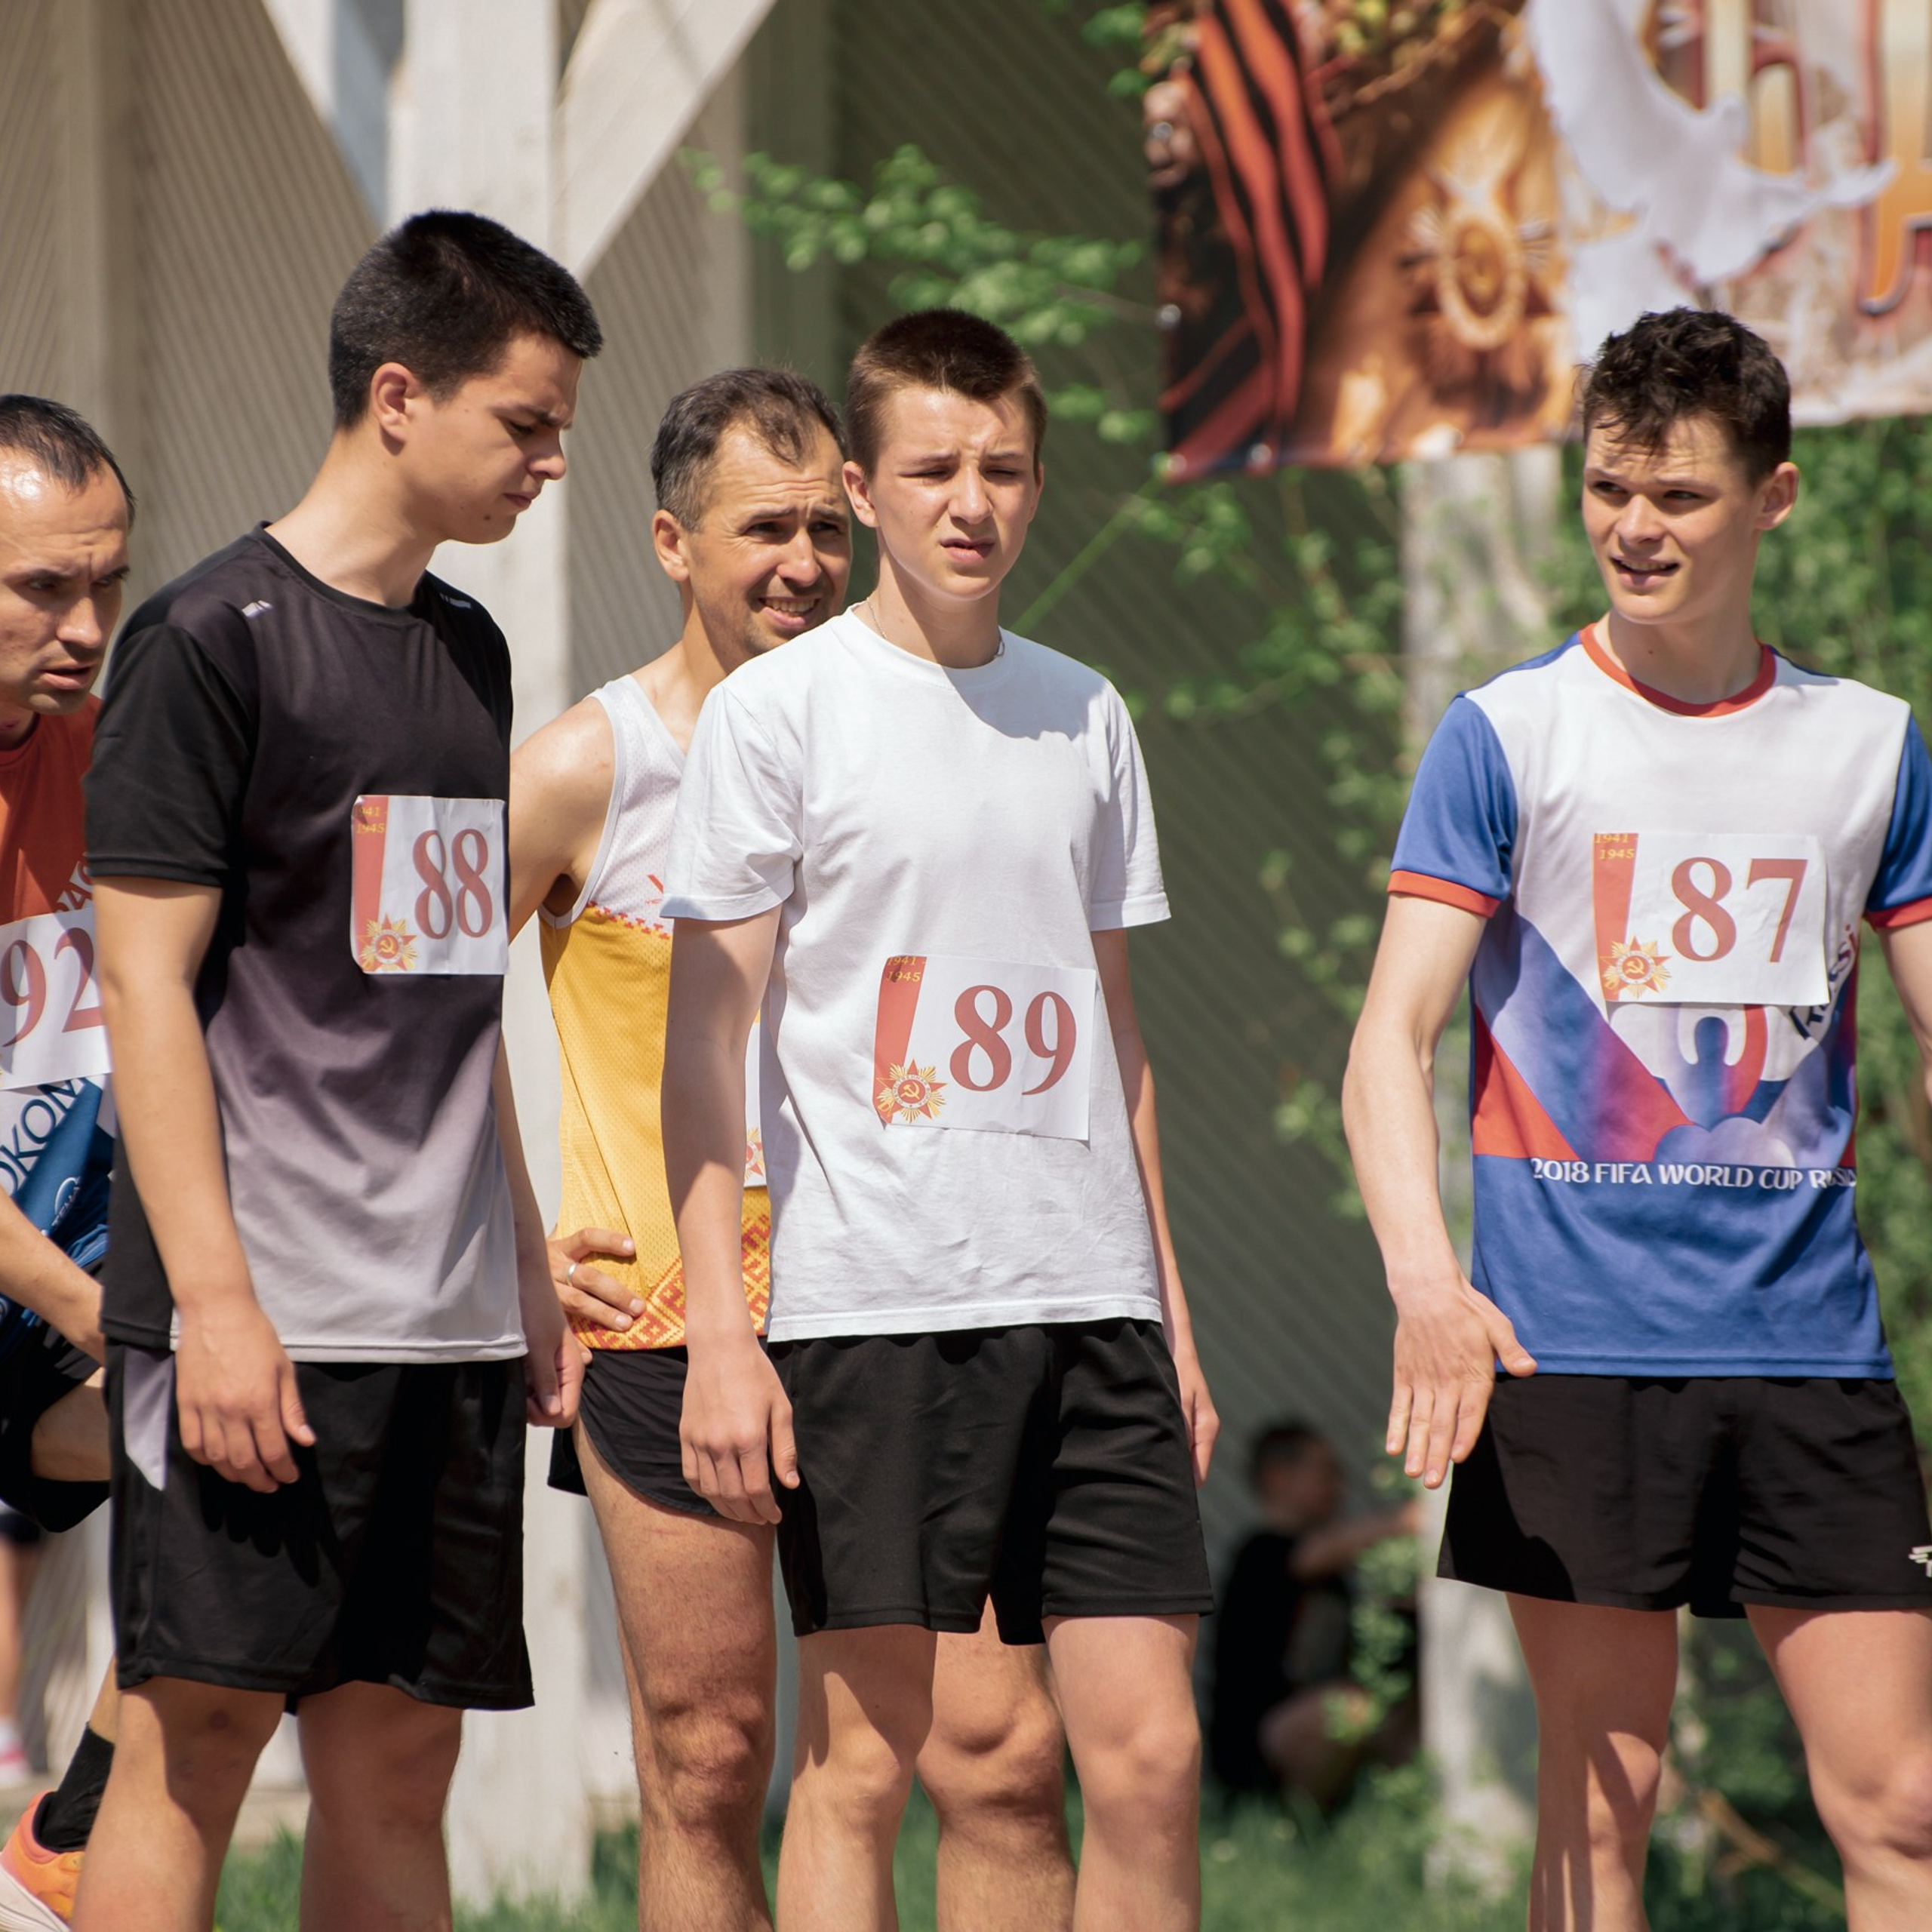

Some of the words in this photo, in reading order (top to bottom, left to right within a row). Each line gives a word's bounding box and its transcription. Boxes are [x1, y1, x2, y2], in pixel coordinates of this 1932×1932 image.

[412, 829, 493, 940] 88
[1599, 848, 1635, 859] 1945
[1671, 857, 1809, 963] 87
[0, 927, 105, 1048] 92
[886, 971, 921, 982] 1945
[949, 985, 1077, 1096] 89
[1531, 1157, 1590, 1183] 2018
[1595, 1163, 1653, 1185] FIFA
[1658, 1164, 1754, 1188] WORLD
[1758, 1169, 1803, 1190] CUP
